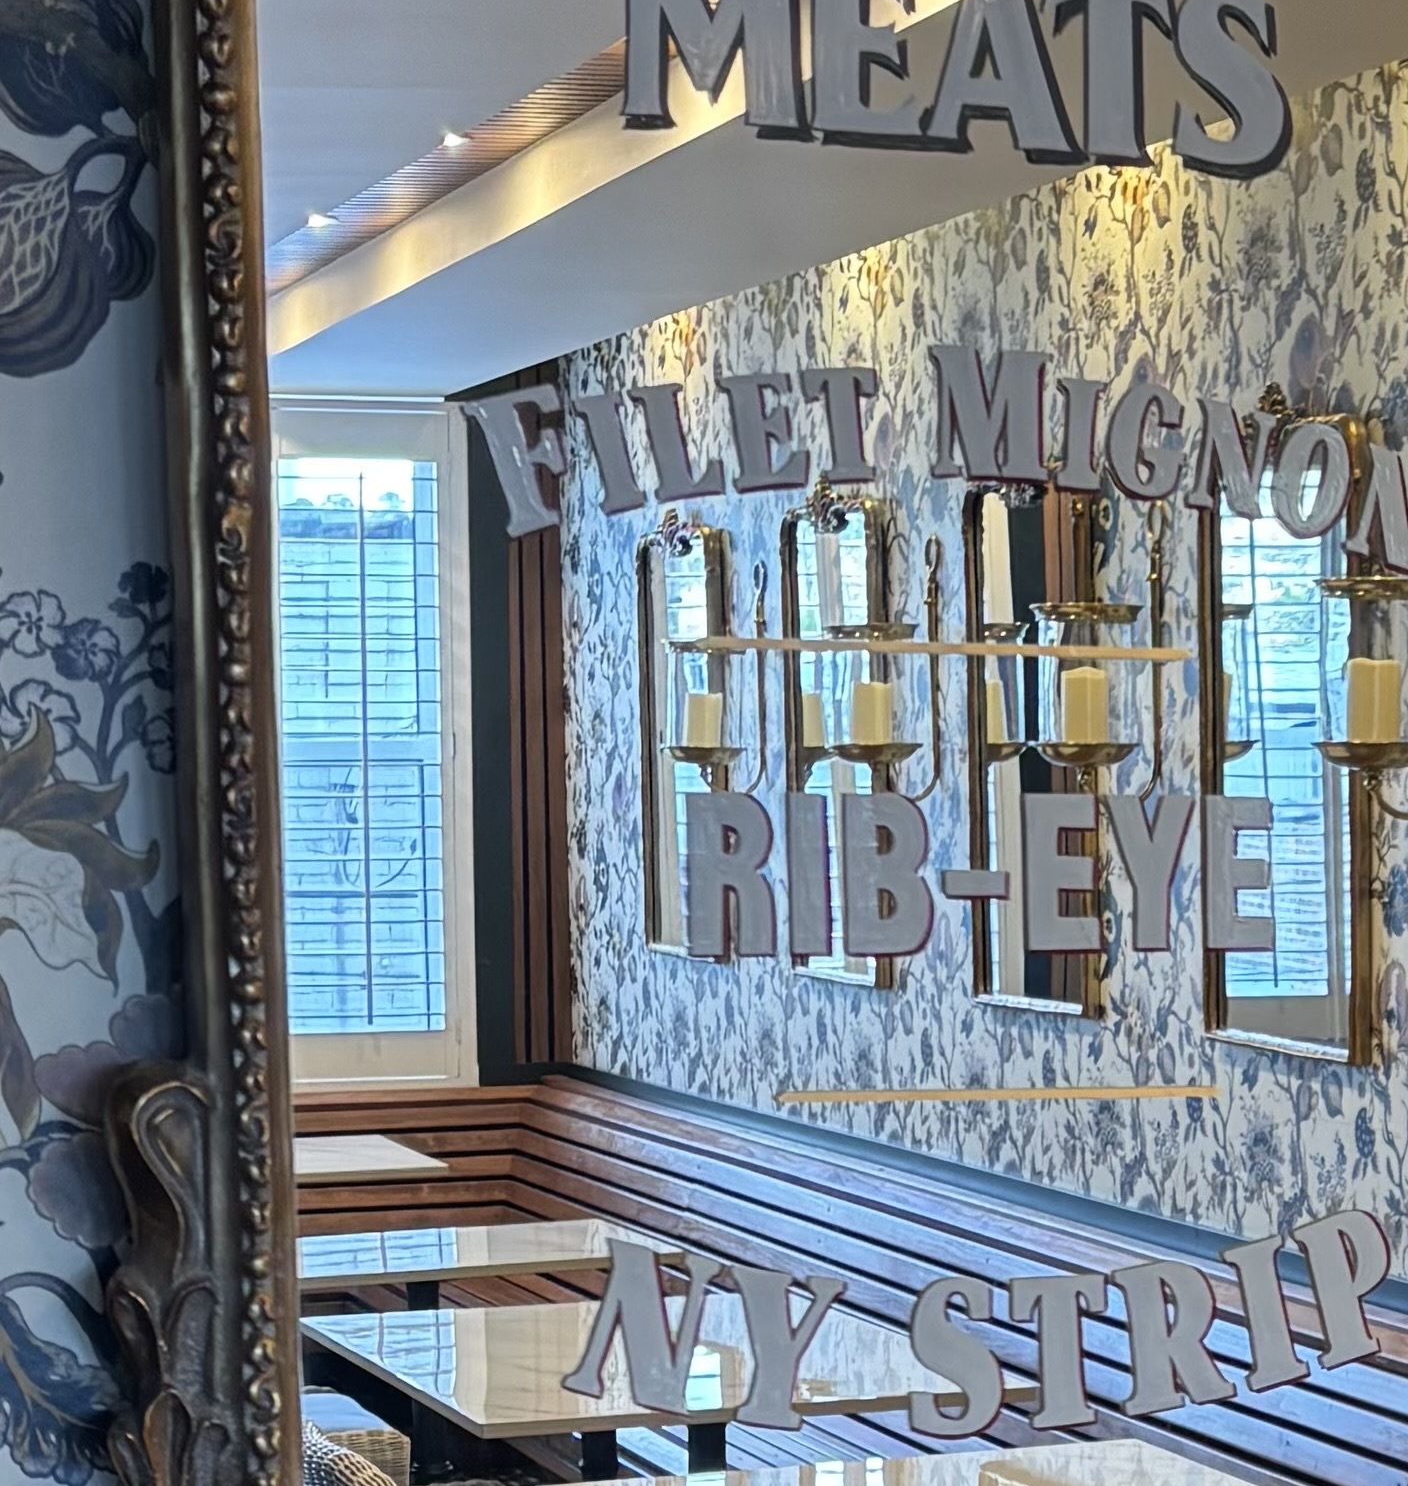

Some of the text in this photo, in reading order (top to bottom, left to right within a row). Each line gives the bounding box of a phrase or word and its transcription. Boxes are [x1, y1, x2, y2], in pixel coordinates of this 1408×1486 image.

[460, 366, 880, 539] FILET
[685, 791, 1277, 957] RIB-EYE
[562, 1208, 1392, 1439] NY STRIP
